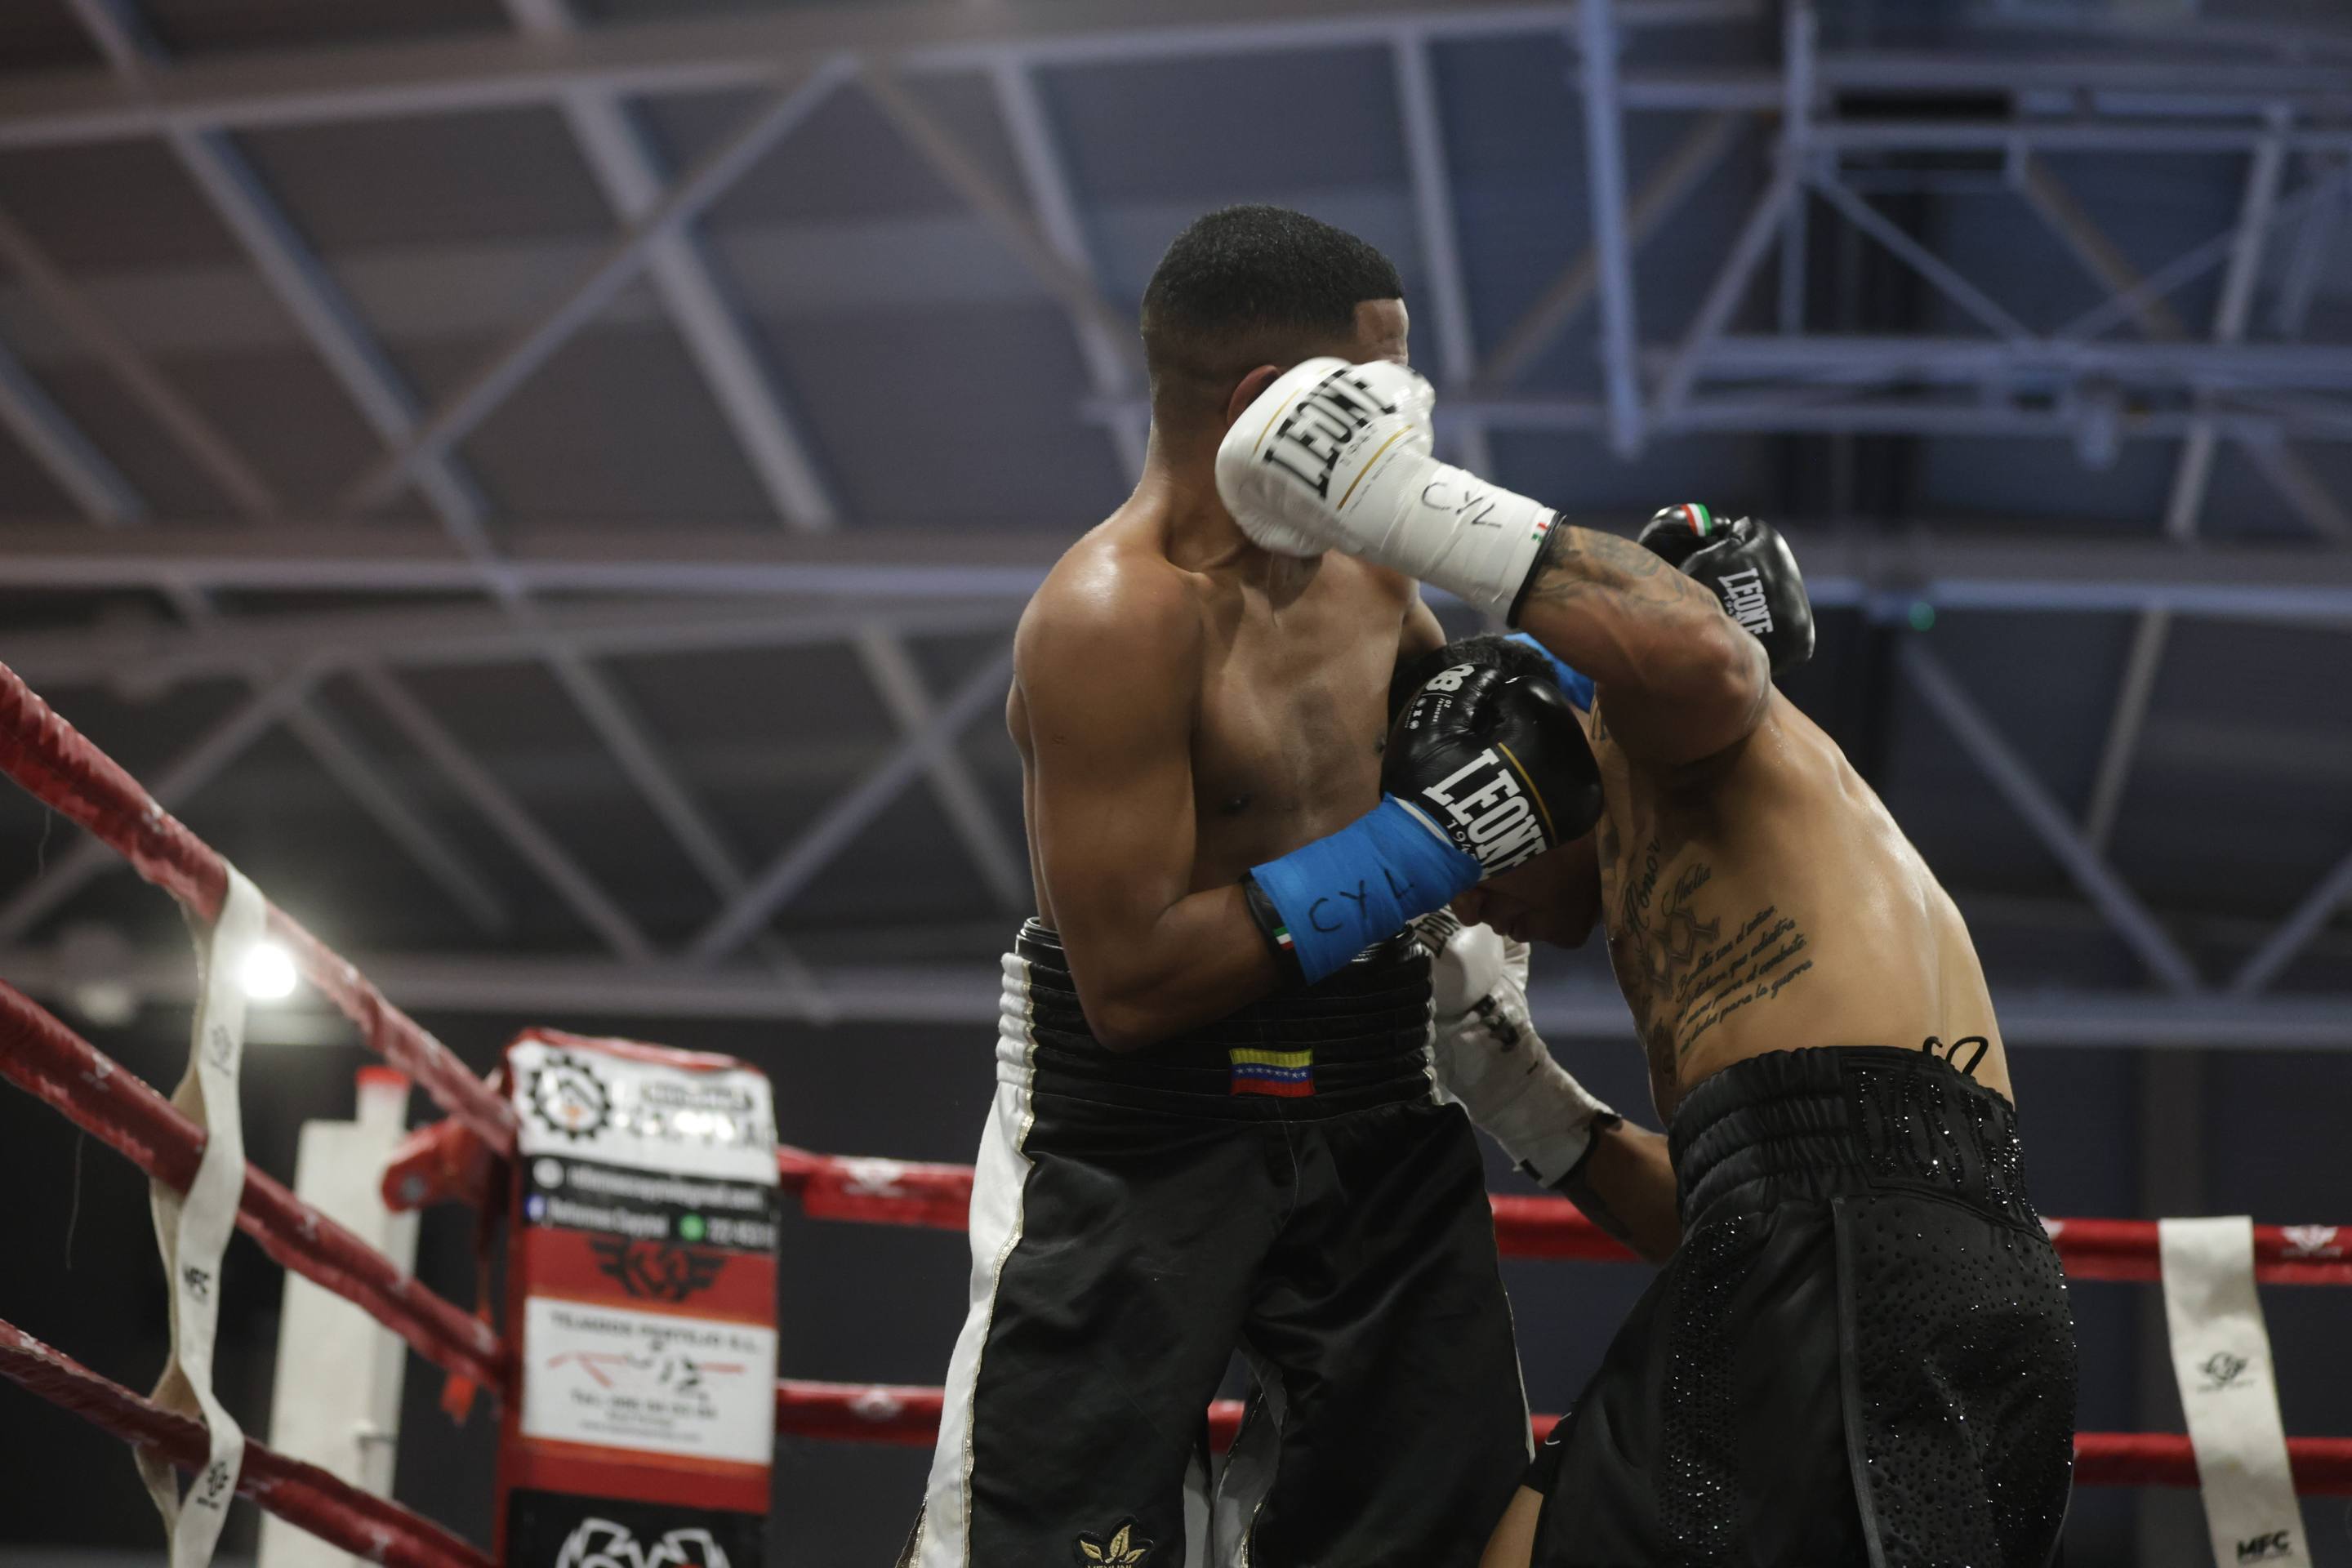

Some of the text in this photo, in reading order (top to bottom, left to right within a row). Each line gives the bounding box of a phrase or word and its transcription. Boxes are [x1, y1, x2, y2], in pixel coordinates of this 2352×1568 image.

[1263, 368, 1401, 501] LEONE
[1717, 567, 1774, 635] LEONE
[1421, 747, 1548, 882] LEONE
[1413, 906, 1460, 959] LEON
